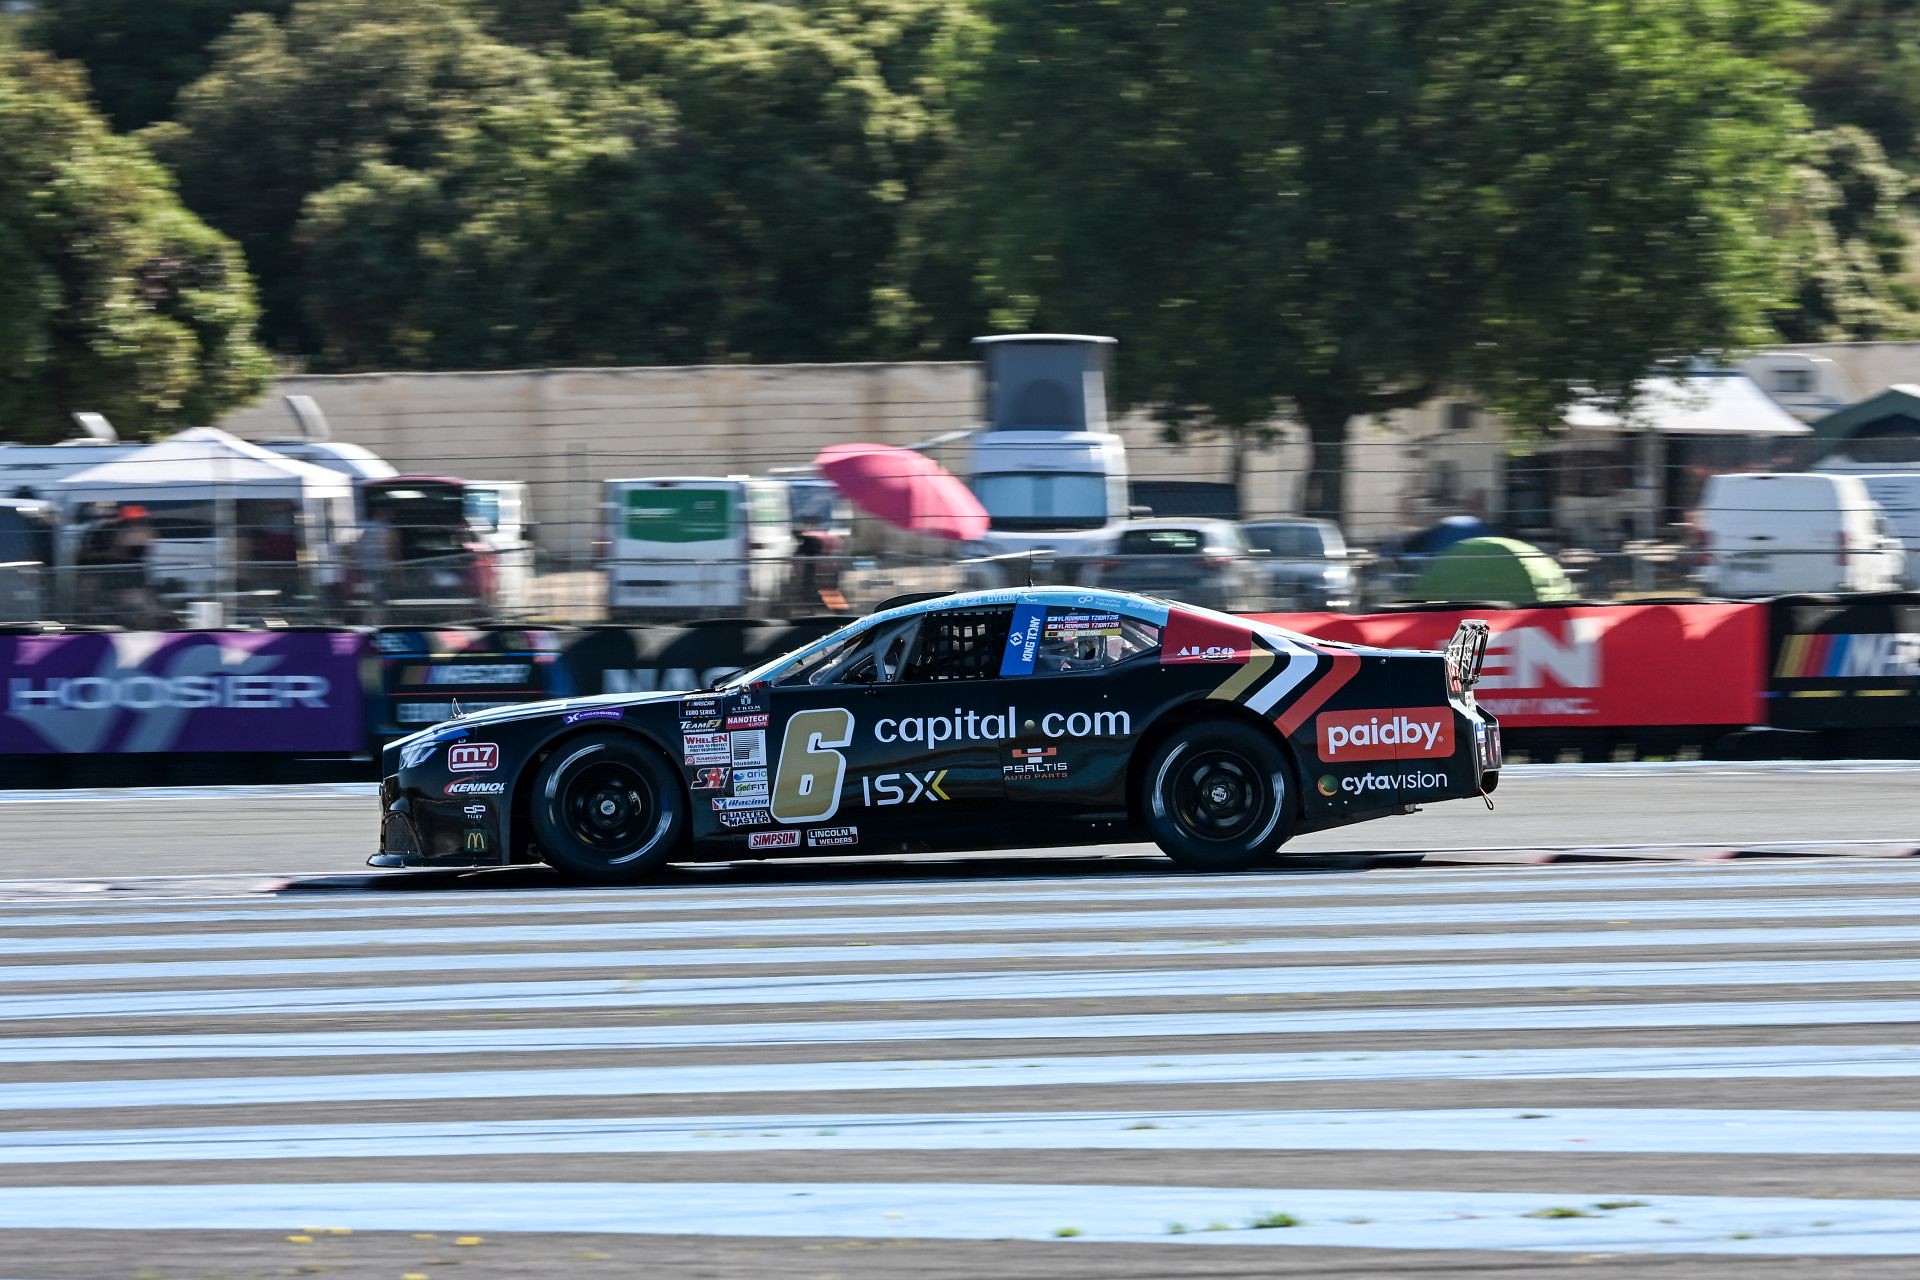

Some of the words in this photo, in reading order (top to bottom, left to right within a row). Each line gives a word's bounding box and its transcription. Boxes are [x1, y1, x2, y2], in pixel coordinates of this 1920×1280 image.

[1028, 616, 1041, 639] TONY
[1022, 641, 1036, 662] KING
[8, 675, 331, 710] HOOSIER
[727, 715, 768, 724] NANOTECH
[685, 734, 728, 744] WHELEN
[1327, 716, 1441, 755] paidby
[770, 707, 856, 824] 6
[1003, 763, 1068, 774] PSALTIS
[1034, 772, 1068, 780] PARTS
[447, 782, 505, 793] KENNOL
[1341, 771, 1448, 795] cytavision
[729, 798, 769, 807] iRacing
[721, 811, 766, 823] QUARTER
[729, 816, 769, 827] MASTER
[752, 832, 798, 847] SIMPSON
[810, 829, 849, 839] LINCOLN
[819, 836, 853, 845] WELDERS
